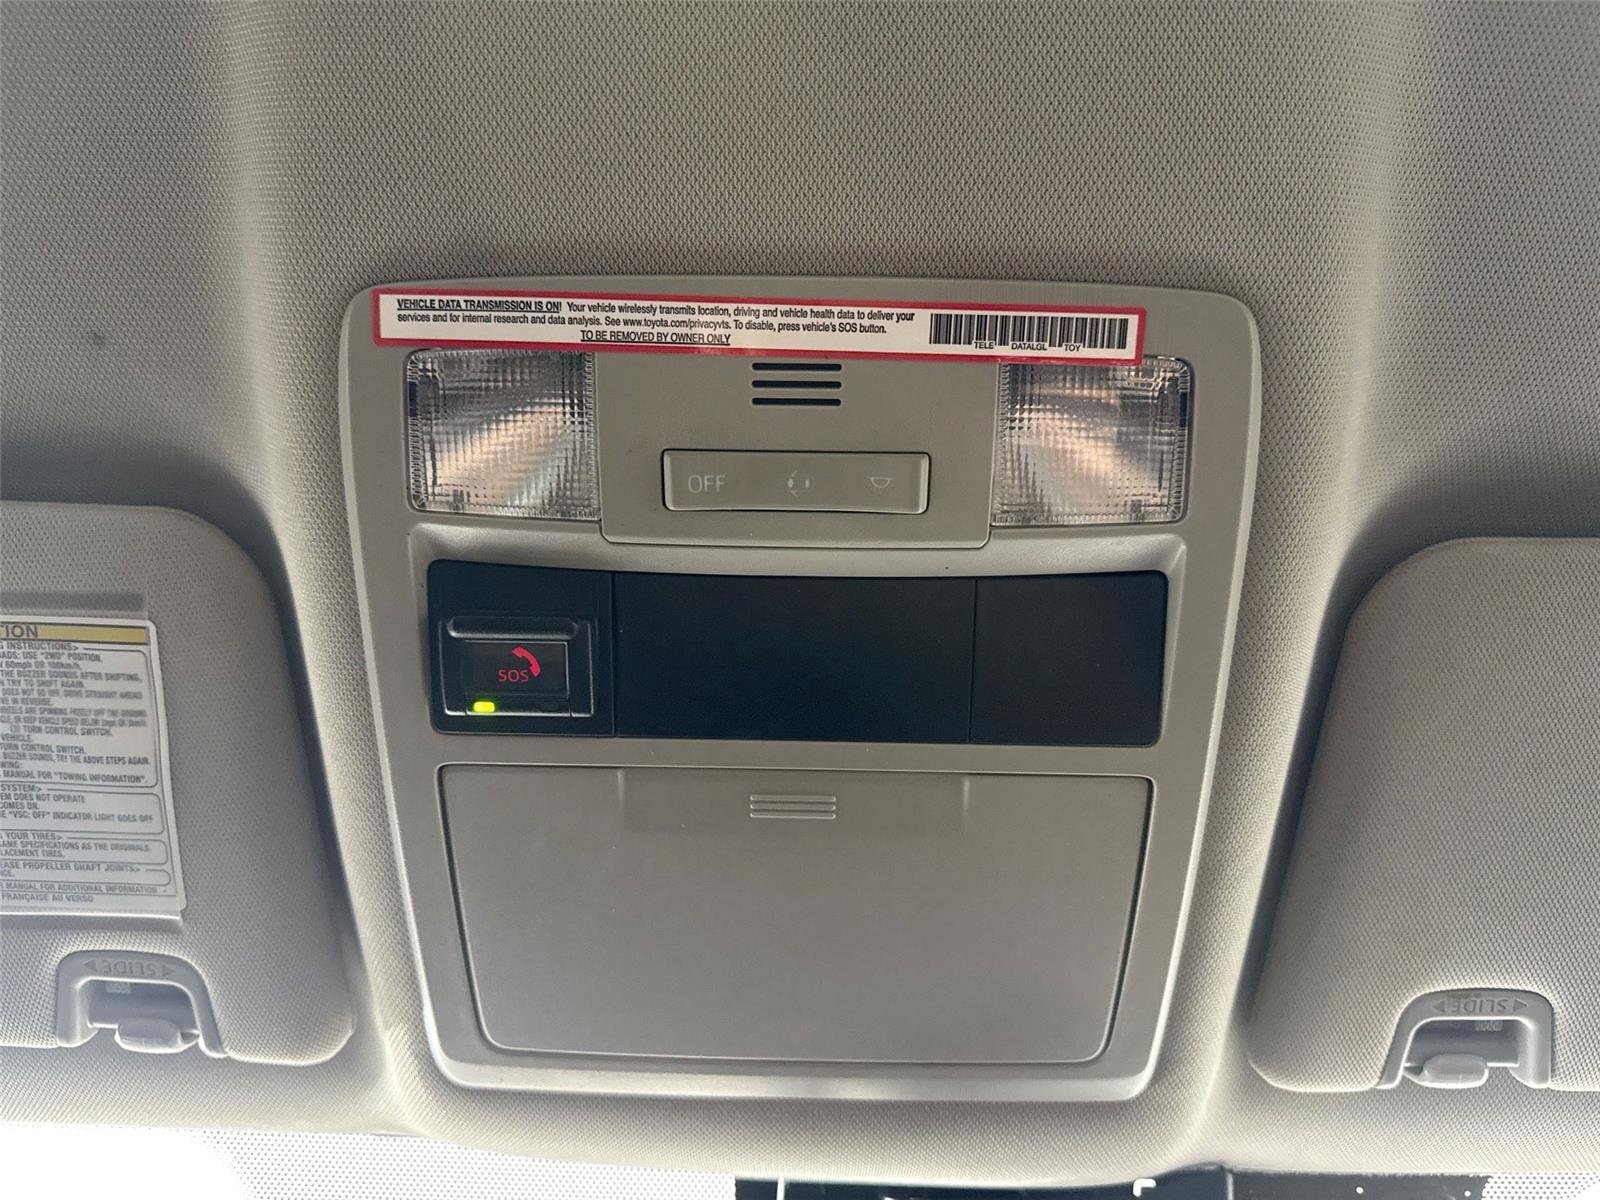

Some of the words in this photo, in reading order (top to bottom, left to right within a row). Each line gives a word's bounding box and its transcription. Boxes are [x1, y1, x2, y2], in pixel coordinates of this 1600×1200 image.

[397, 299, 436, 309] VEHICLE
[438, 300, 462, 309] DATA
[464, 301, 532, 311] TRANSMISSION
[534, 302, 544, 311] IS
[545, 302, 562, 312] ON!
[567, 303, 586, 312] Your
[587, 303, 616, 313] vehicle
[618, 303, 657, 315] wirelessly
[659, 305, 696, 315] transmits
[698, 305, 731, 317] location,
[733, 307, 760, 319] driving
[762, 307, 778, 318] and
[780, 308, 808, 318] vehicle
[810, 308, 834, 319] health
[836, 309, 855, 319] data
[857, 310, 865, 320] to
[867, 310, 894, 320] deliver
[896, 312, 915, 323] your
[397, 314, 430, 322] services
[432, 313, 448, 322] and
[450, 313, 460, 322] for
[462, 314, 492, 323] internal
[494, 314, 529, 323] research
[531, 314, 546, 324] and
[548, 315, 567, 325] data
[568, 315, 603, 327] analysis.
[605, 316, 621, 326] See
[734, 319, 744, 329] To
[745, 320, 776, 332] disable,
[778, 323, 800, 333] press
[802, 322, 836, 332] vehicle's
[838, 323, 857, 333] SOS
[860, 323, 887, 334] button.
[581, 330, 594, 340] TO
[596, 330, 608, 341] BE
[610, 331, 654, 342] REMOVED
[657, 332, 669, 342] BY
[670, 332, 704, 344] OWNER
[706, 333, 731, 344] ONLY
[974, 342, 995, 350] TELE
[1011, 342, 1047, 351] DATALGL
[1064, 343, 1081, 352] TOY
[688, 474, 726, 493] OFF
[498, 669, 529, 682] SOS
[37, 771, 52, 779] FOR
[5, 832, 31, 840] YOUR
[81, 842, 92, 850] AS
[102, 960, 155, 976] SLIDE
[1450, 1000, 1506, 1014] SLIDE
